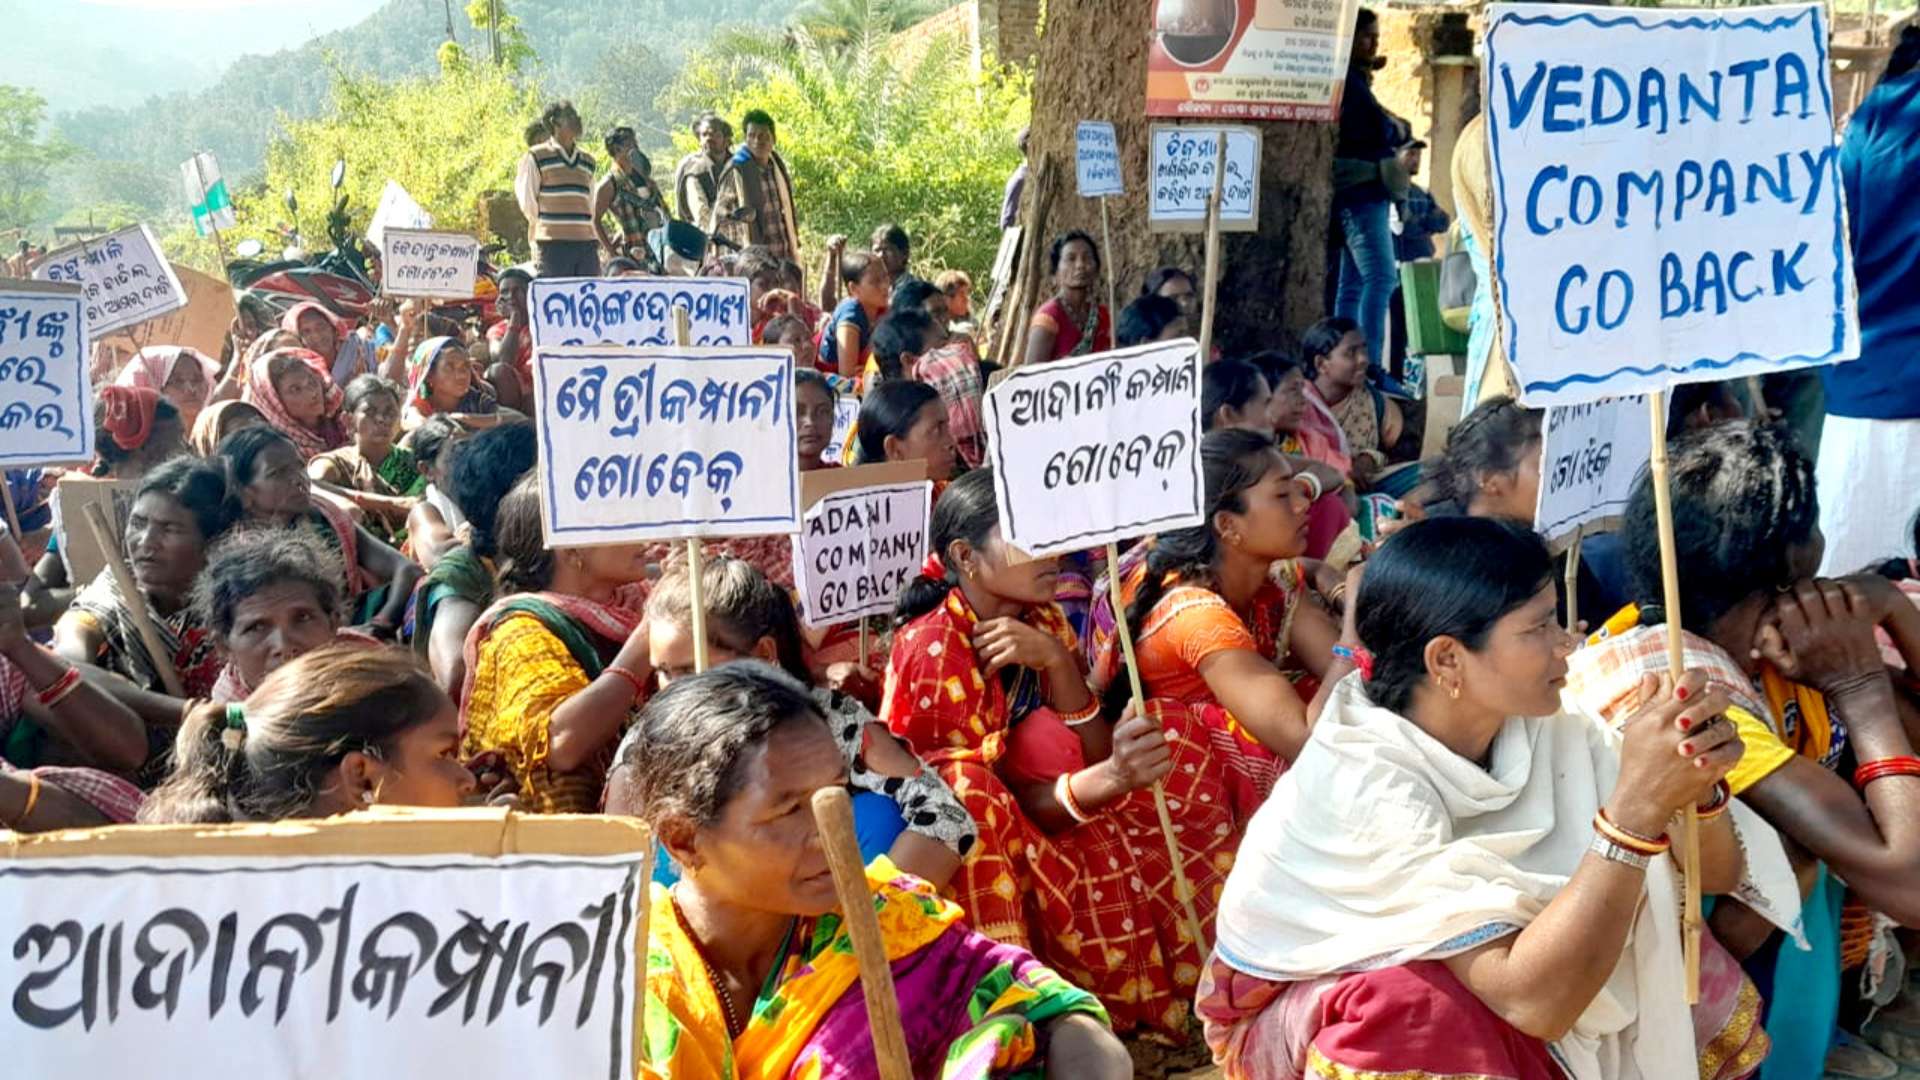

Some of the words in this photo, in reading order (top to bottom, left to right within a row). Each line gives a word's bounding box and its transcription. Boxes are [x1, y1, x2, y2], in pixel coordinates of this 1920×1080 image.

[1499, 52, 1813, 134] VEDANTA
[1525, 145, 1841, 236] COMPANY
[1554, 263, 1634, 335] GO
[1659, 242, 1816, 320] BACK
[808, 496, 891, 537] ADANI
[815, 531, 921, 574] COMPANY
[819, 579, 848, 614] GO
[856, 565, 909, 602] BACK
